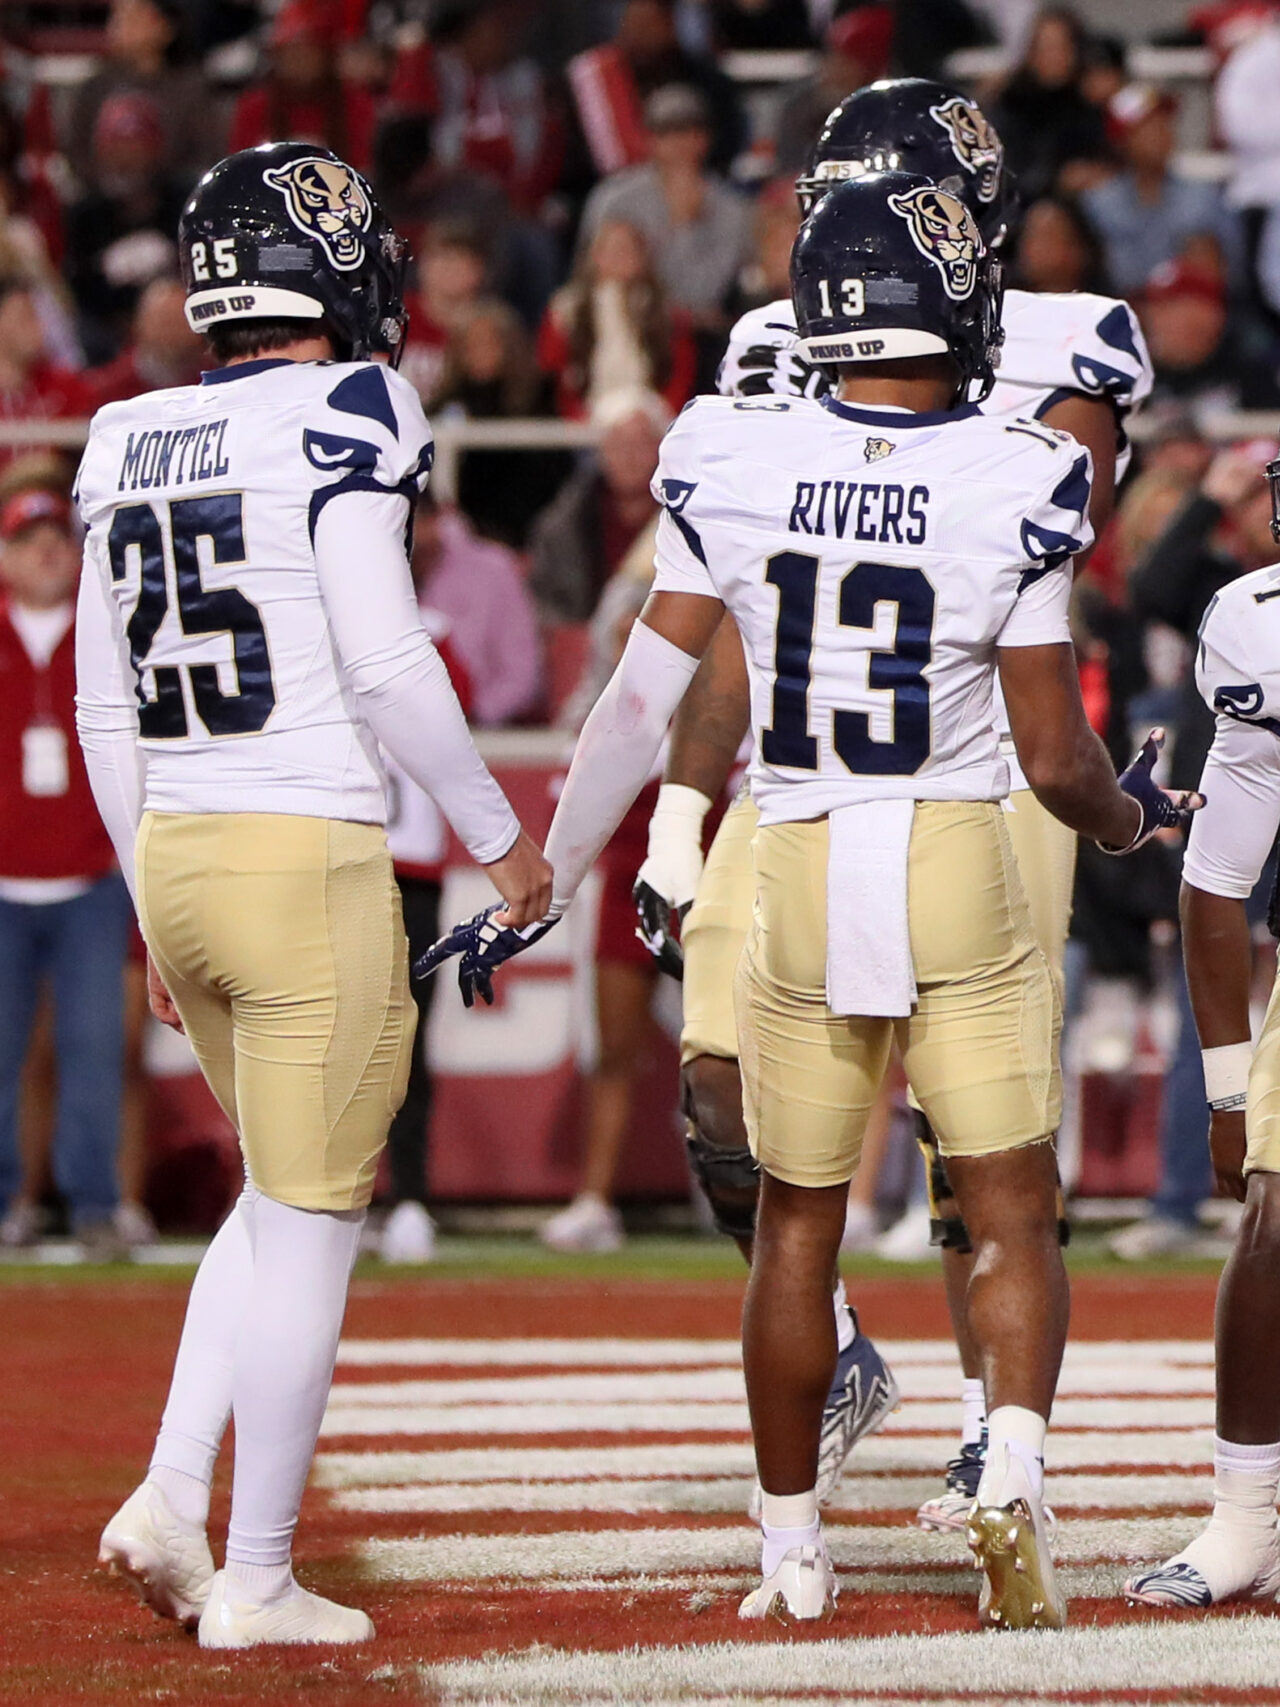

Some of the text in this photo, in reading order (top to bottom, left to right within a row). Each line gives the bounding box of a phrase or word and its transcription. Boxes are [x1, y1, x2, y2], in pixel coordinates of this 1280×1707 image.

[190, 237, 240, 282] 25
[190, 295, 256, 321] PAWS UP
[817, 278, 866, 318] 13
[807, 340, 886, 360] PAWS UP
[117, 418, 230, 492] MONTIEL
[788, 480, 930, 546] RIVERS
[106, 490, 277, 741] 25
[759, 549, 939, 778] 13
